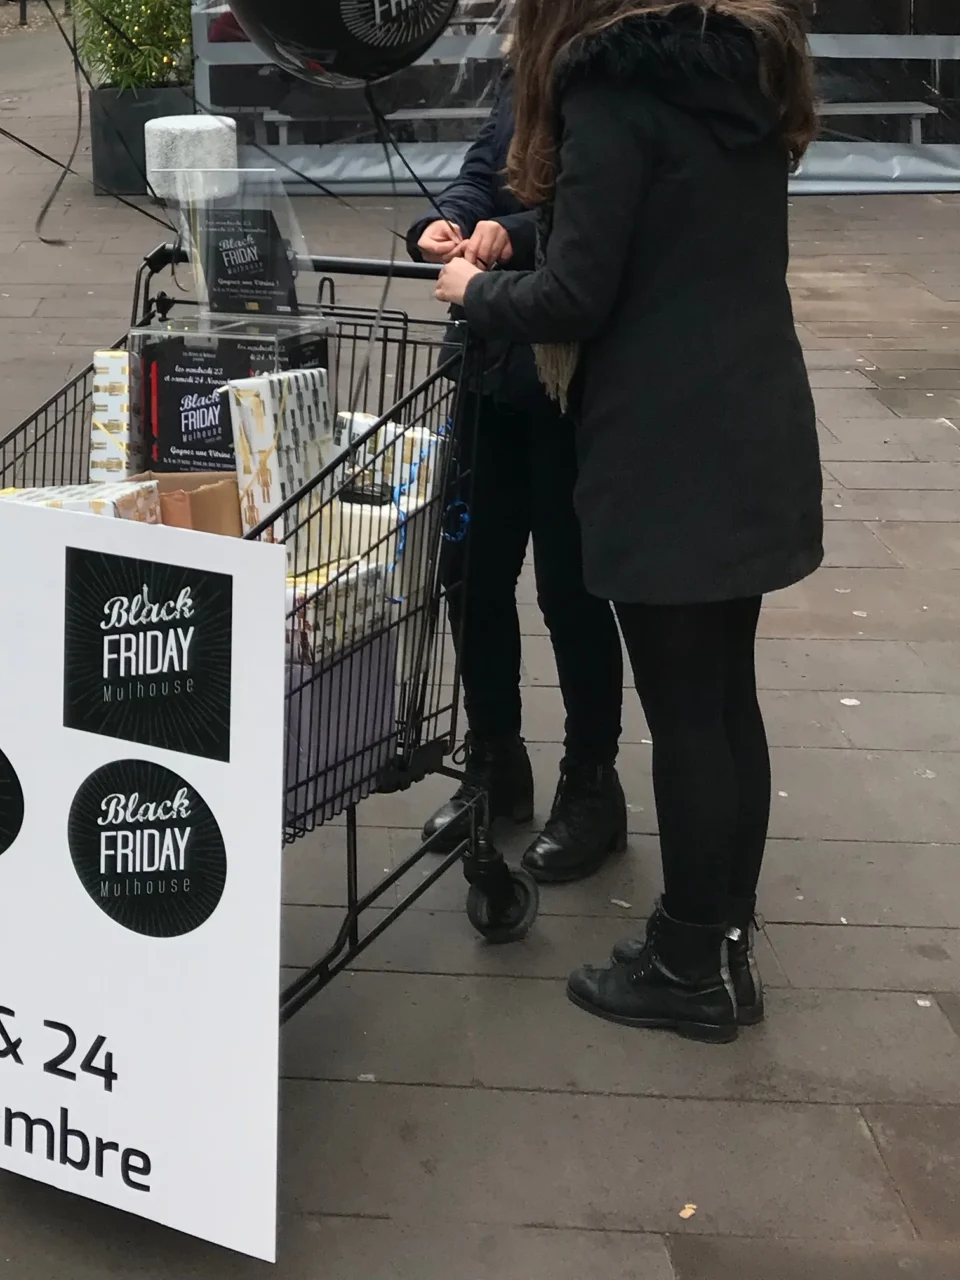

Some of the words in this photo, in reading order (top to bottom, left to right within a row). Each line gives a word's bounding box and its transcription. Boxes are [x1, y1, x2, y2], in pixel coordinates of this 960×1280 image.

[218, 233, 256, 252] Black
[221, 245, 259, 267] FRIDAY
[179, 389, 221, 412] Black
[181, 404, 221, 433] FRIDAY
[182, 426, 223, 443] Mulhouse
[100, 584, 195, 630] Black
[103, 626, 195, 679] FRIDAY
[103, 678, 194, 702] Mulhouse
[97, 786, 192, 826] Black
[100, 826, 191, 874] FRIDAY
[100, 877, 190, 898] Mulhouse
[42, 1019, 119, 1093] 24
